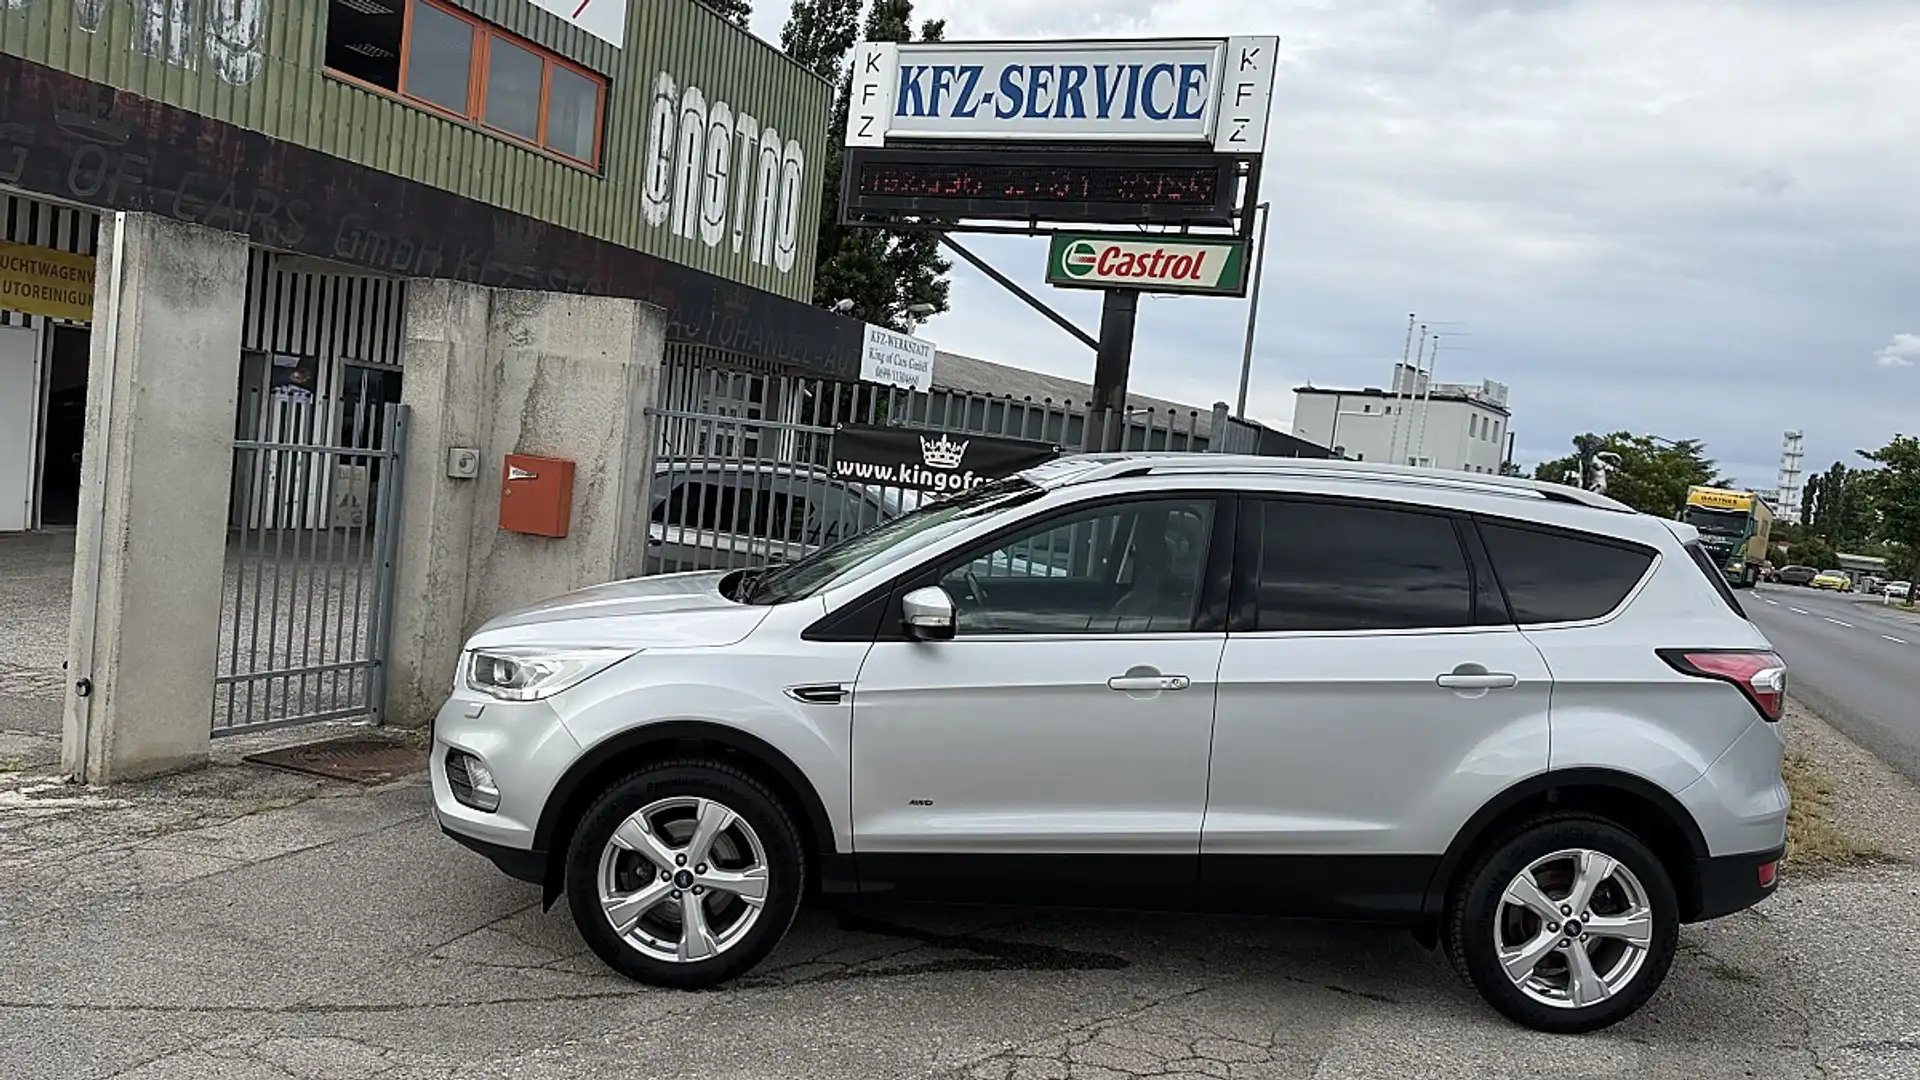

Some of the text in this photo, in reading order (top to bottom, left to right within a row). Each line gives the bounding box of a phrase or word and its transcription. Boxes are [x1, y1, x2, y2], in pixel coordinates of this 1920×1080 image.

[857, 52, 881, 137] KFZ
[894, 63, 1208, 121] KFZ-SERVICE
[1228, 48, 1260, 143] KFZ
[1097, 246, 1206, 280] Castrol
[870, 329, 930, 358] KFZ-WERKSTATT
[836, 460, 995, 491] www.kingofc
